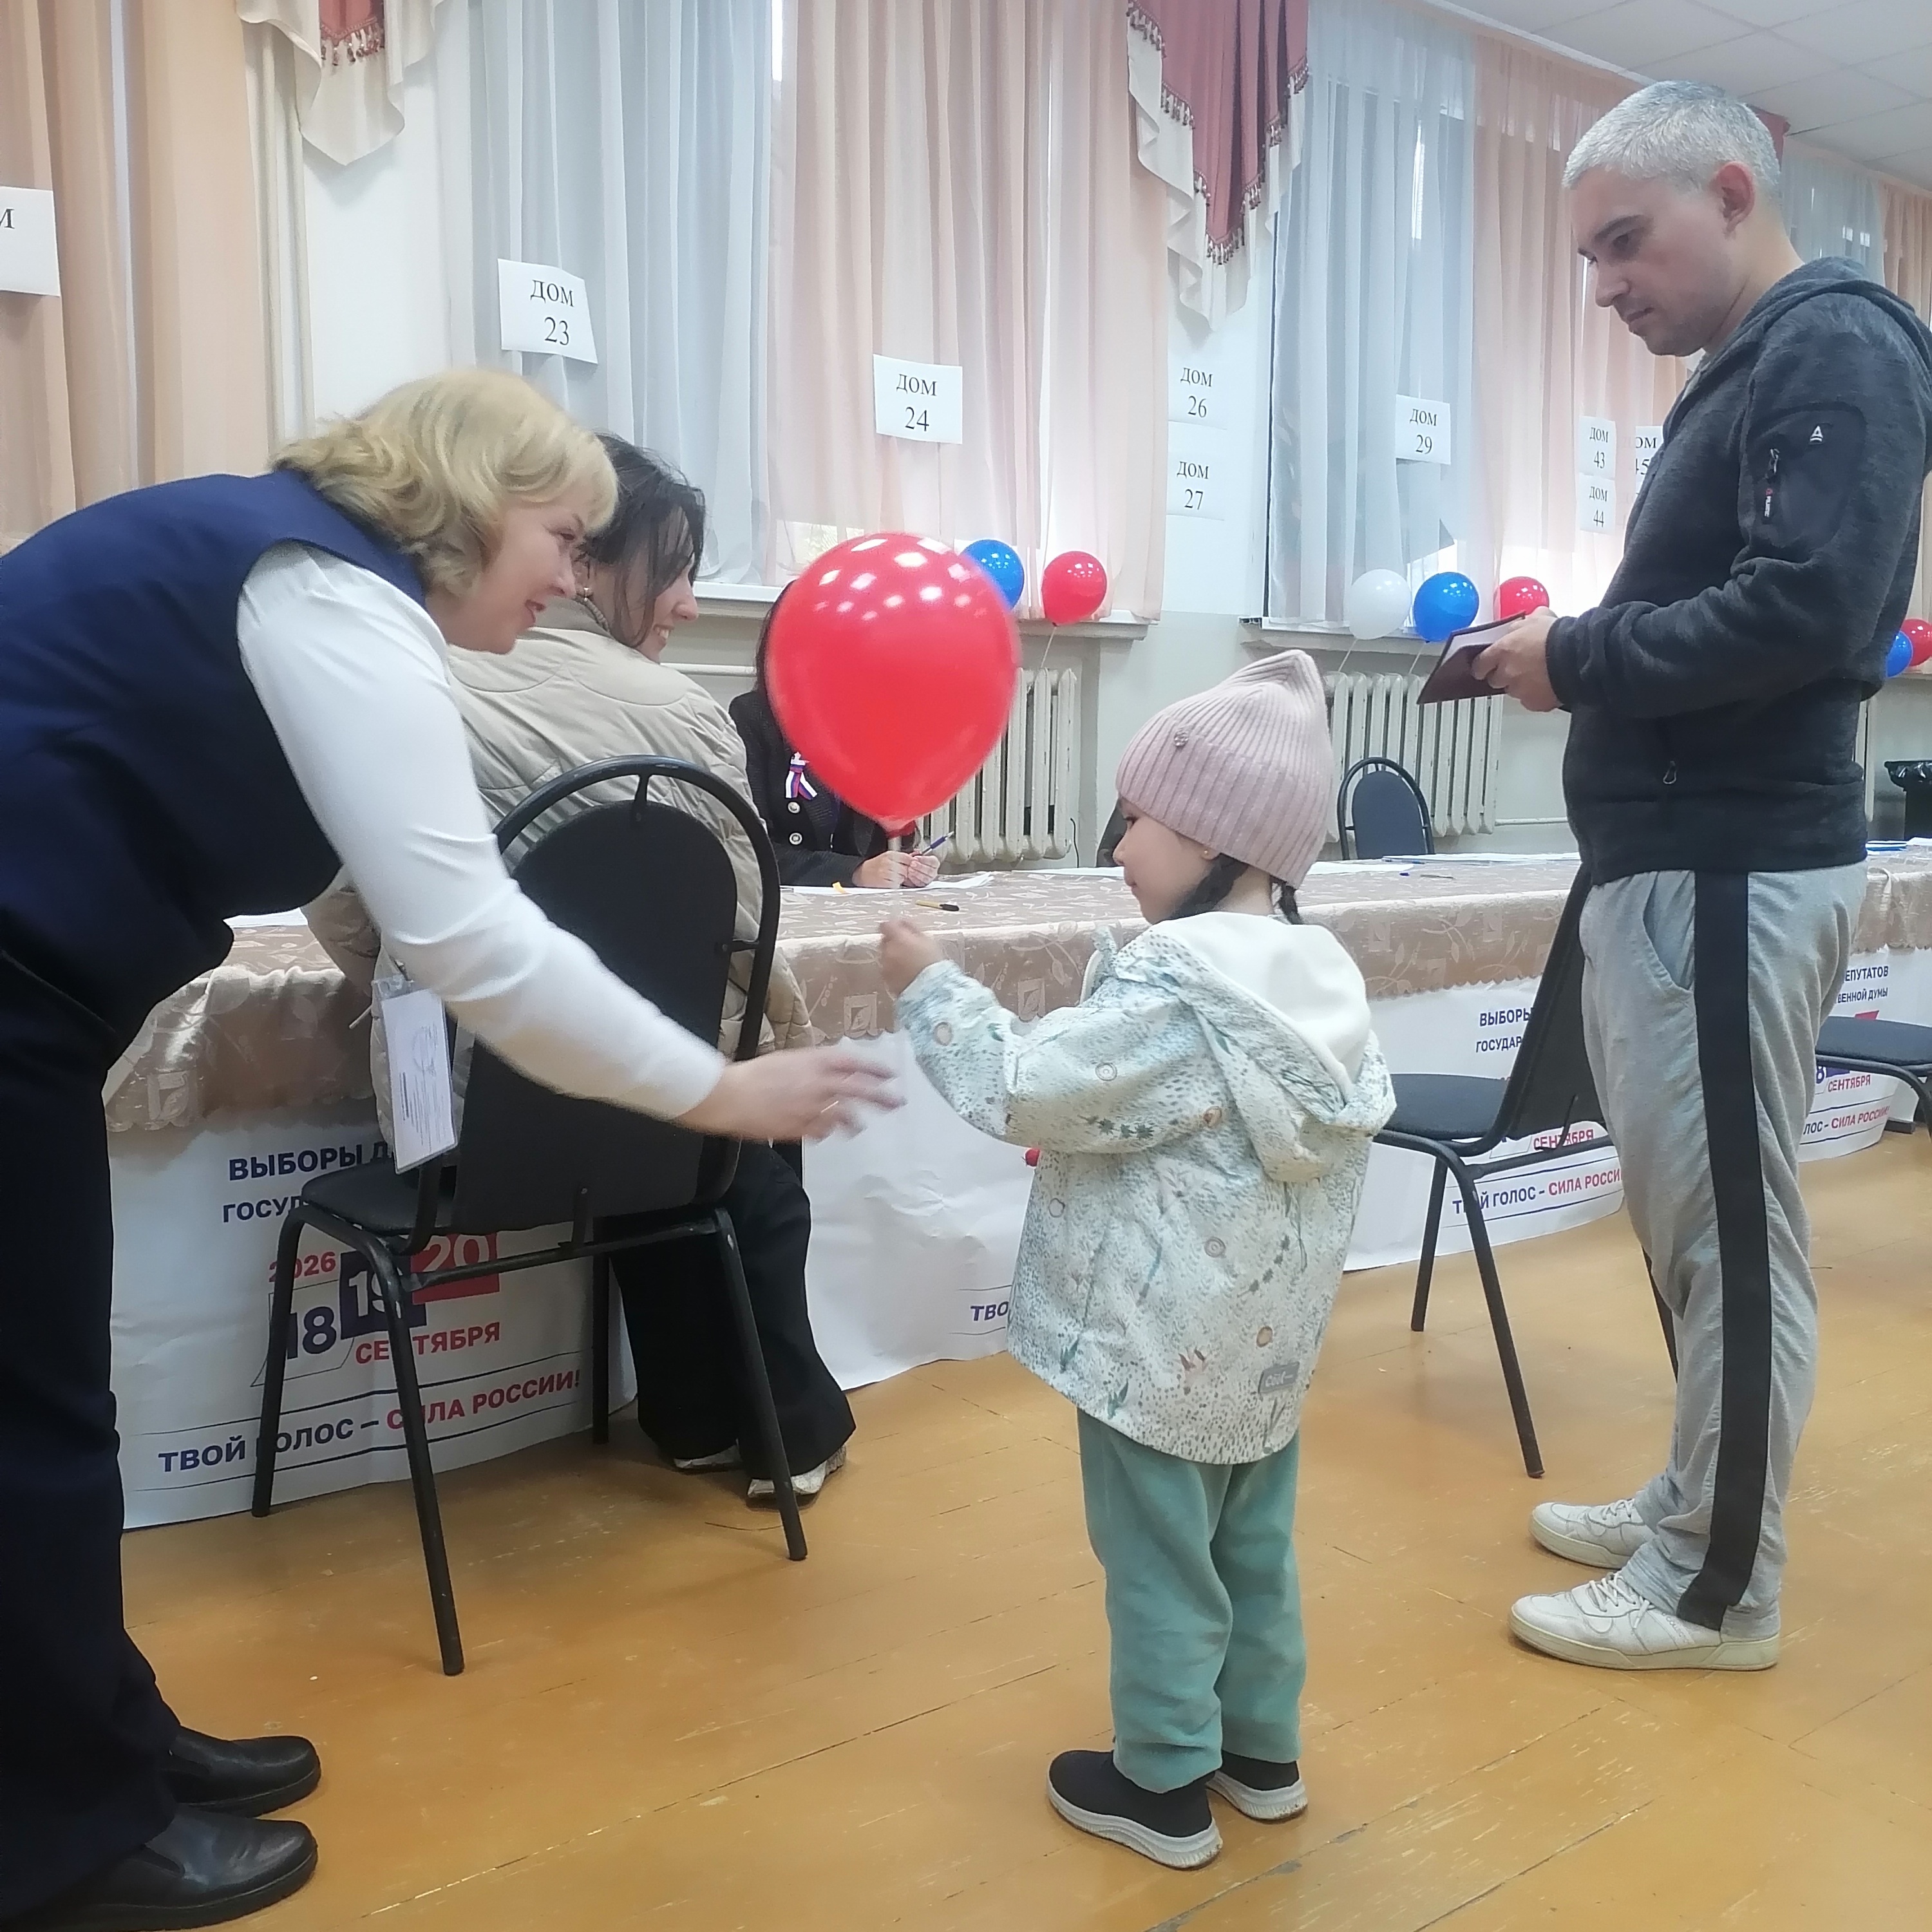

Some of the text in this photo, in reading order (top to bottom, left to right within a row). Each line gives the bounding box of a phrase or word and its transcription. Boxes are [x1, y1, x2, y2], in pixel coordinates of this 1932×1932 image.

[530, 279, 574, 307] ДОМ
[544, 317, 569, 345] 23
[896, 374, 938, 396] ДОМ
[1180, 368, 1213, 387] ДОМ
[1188, 395, 1207, 418] 26
[905, 406, 929, 431] 24
[1410, 408, 1437, 426] ДОМ
[1416, 434, 1432, 455] 29
[1589, 427, 1609, 443] ДОМ
[1594, 451, 1605, 469] 43
[1177, 461, 1209, 481] ДОМ
[1184, 489, 1204, 510] 27
[1589, 486, 1607, 502] ДОМ
[1593, 509, 1604, 527] 44
[1845, 966, 1889, 981] ЕПУТАТОВ
[1838, 987, 1888, 1003] ВЕННОЙ ДУМЫ
[1475, 1036, 1522, 1053] ГОСУДАР
[1828, 1074, 1871, 1092] СЕНТЯБРЯ
[1803, 1121, 1823, 1135] ЛОС
[1832, 1114, 1855, 1129] СИЛА
[1858, 1106, 1890, 1124] РОССИИ!
[229, 1144, 362, 1180] ВЫБОРЫ
[1493, 1186, 1536, 1207] ГОЛОС
[1549, 1178, 1582, 1196] СИЛА
[1585, 1168, 1622, 1189] РОССИ
[971, 1301, 1009, 1321] ТВО
[355, 1321, 500, 1365] СЕТЯБРЯ
[158, 1436, 246, 1472] ТВОЙ
[256, 1419, 354, 1457] ОЛОС
[386, 1399, 465, 1430] СЛА
[473, 1370, 579, 1414] РОССИИ!
